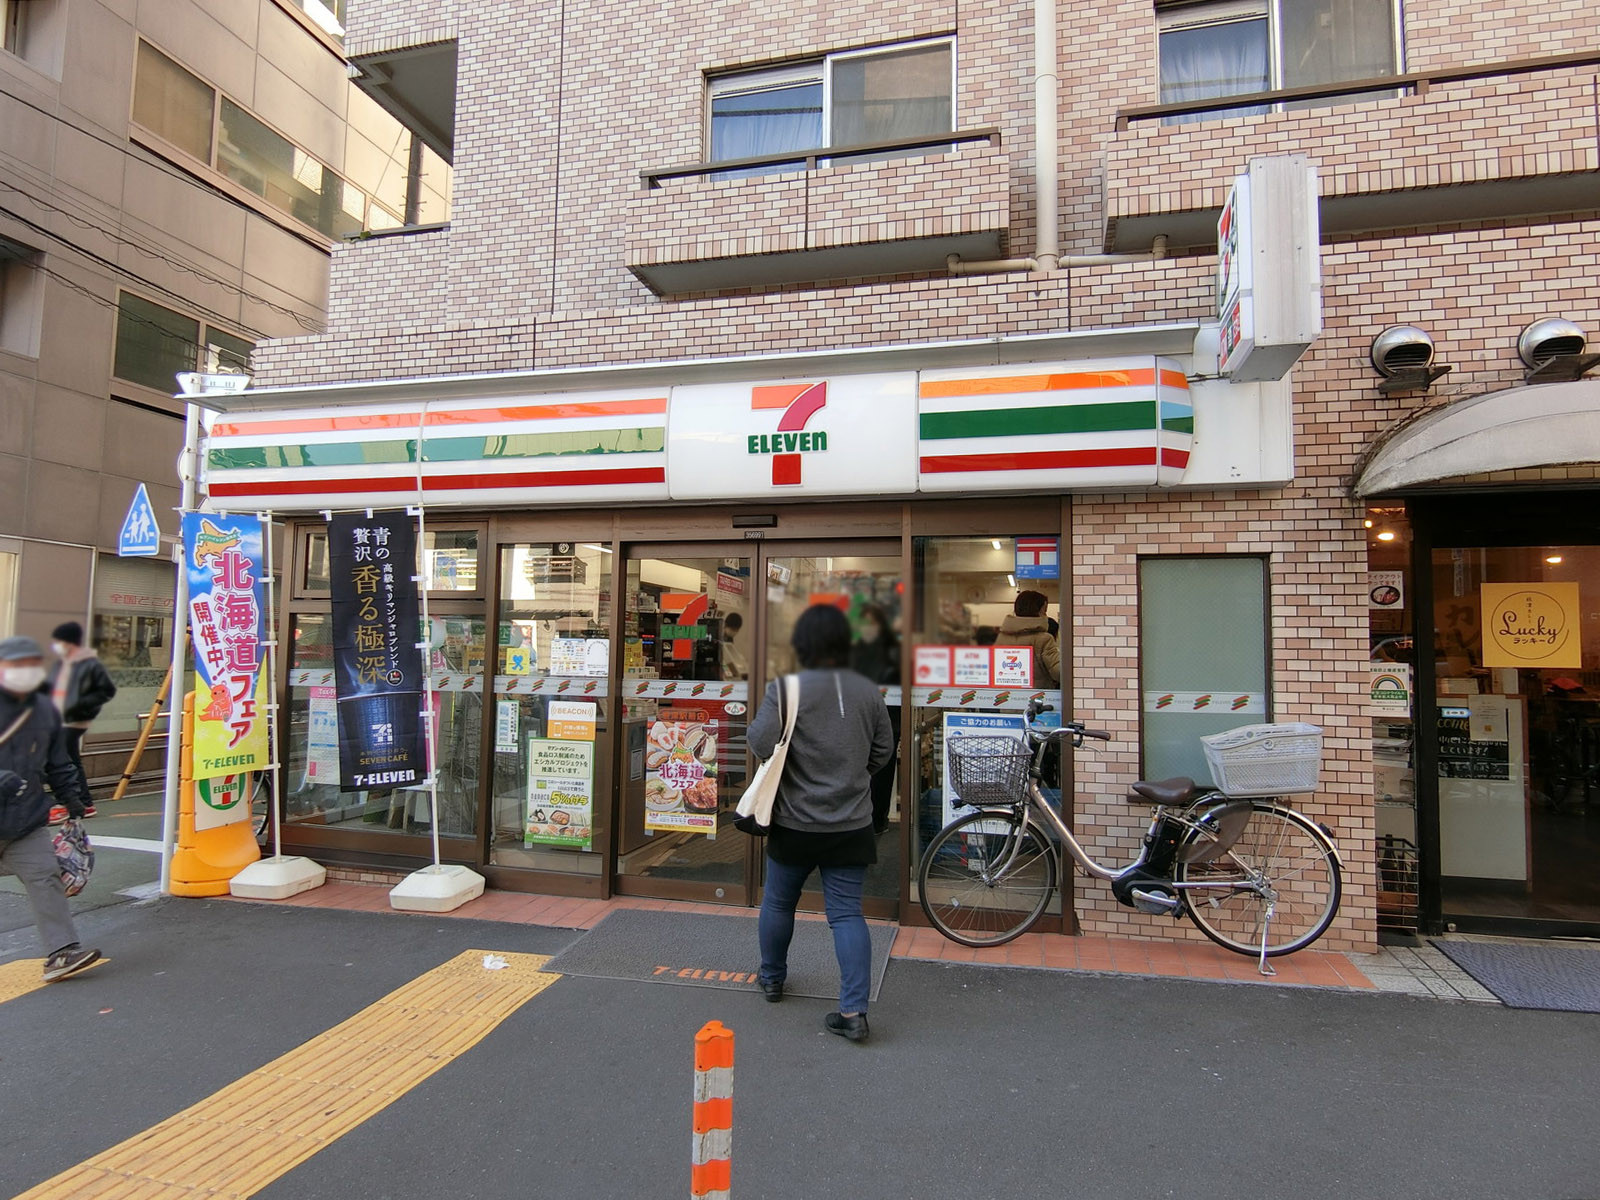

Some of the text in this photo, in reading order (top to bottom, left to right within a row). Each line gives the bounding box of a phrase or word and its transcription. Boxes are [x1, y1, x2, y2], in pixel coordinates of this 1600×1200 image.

[352, 527, 373, 562] 贅沢
[372, 527, 391, 559] 青の
[351, 565, 388, 686] 香る極深
[1499, 610, 1559, 645] Lucky
[1513, 637, 1547, 645] ラッキー
[211, 550, 259, 750] 北海道フェア
[960, 718, 1012, 727] ご協力のお願い
[659, 763, 705, 781] 北海道
[671, 779, 695, 789] フェア
